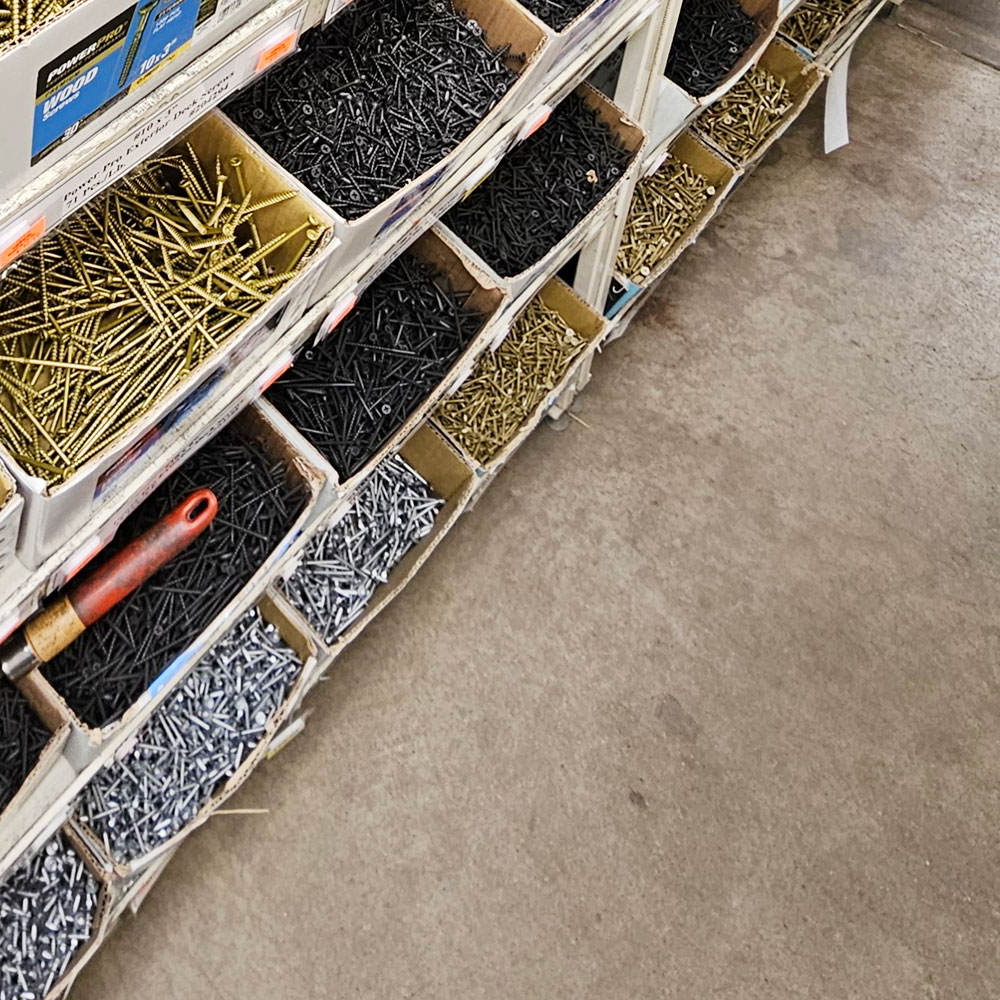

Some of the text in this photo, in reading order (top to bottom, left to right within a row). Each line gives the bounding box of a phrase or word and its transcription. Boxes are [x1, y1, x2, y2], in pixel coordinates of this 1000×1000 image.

[43, 66, 98, 114] WOOD
[43, 91, 80, 121] Screws
[63, 101, 198, 201] Power Pro Exterior Deck
